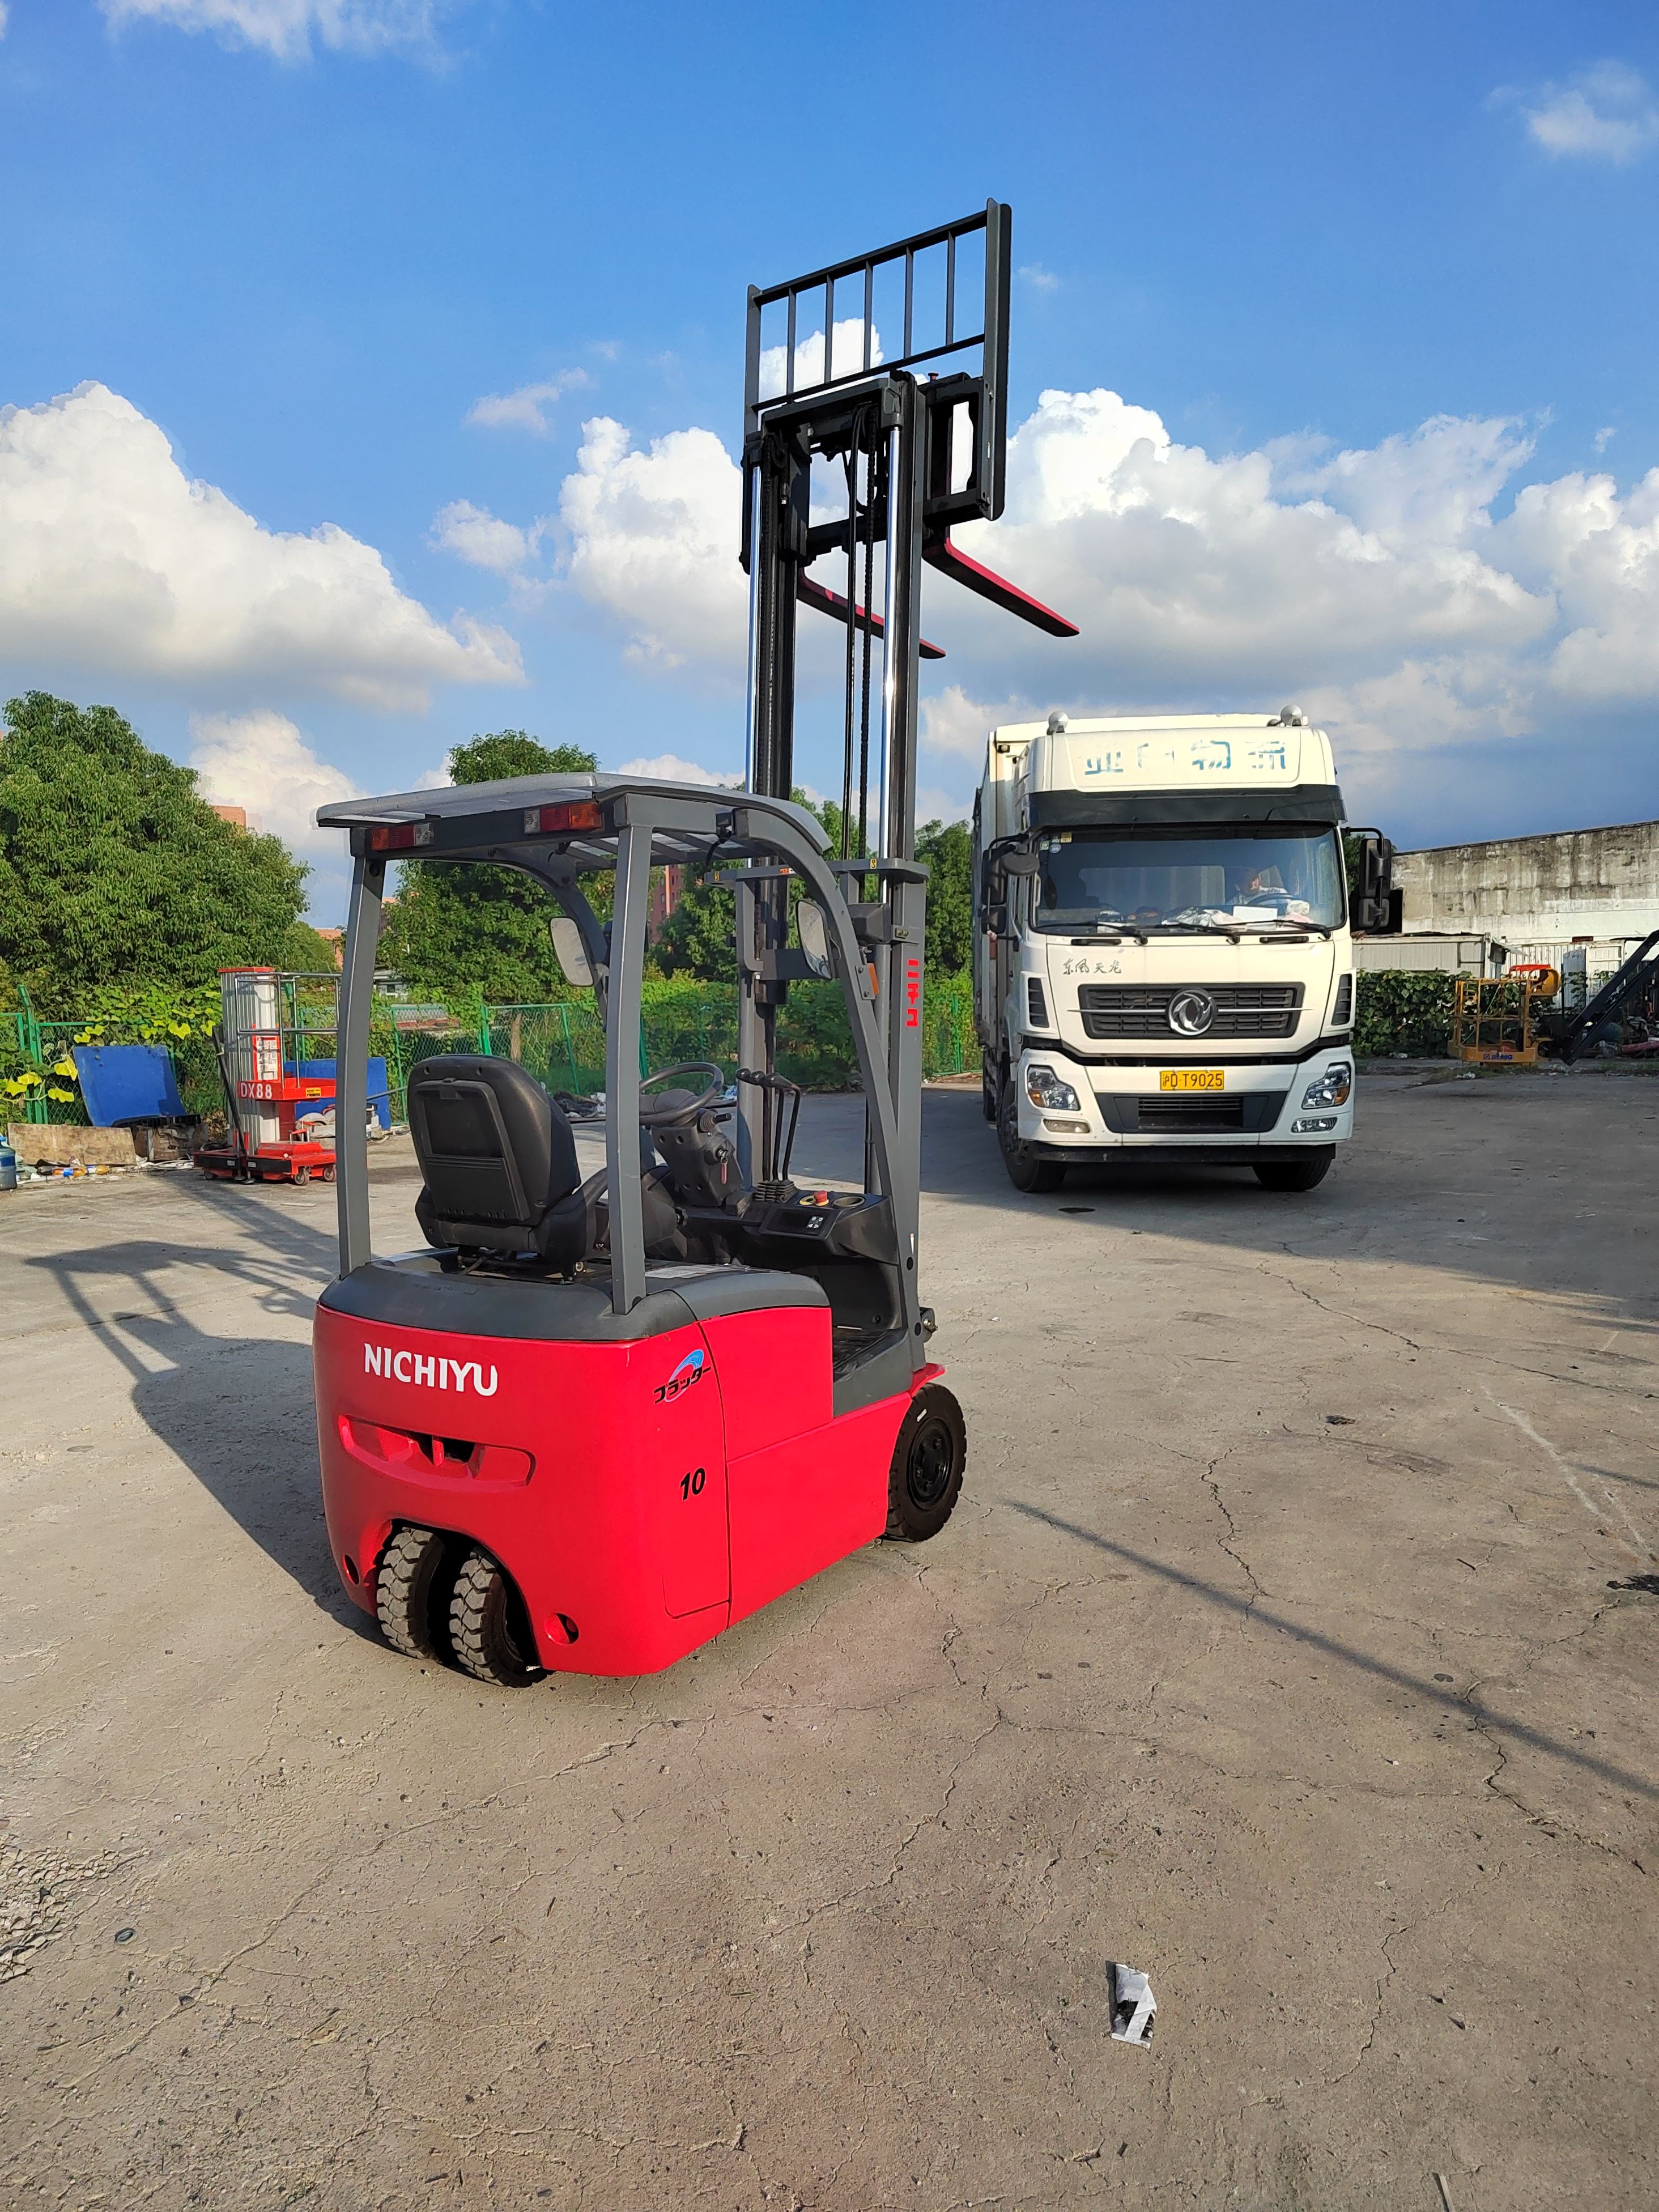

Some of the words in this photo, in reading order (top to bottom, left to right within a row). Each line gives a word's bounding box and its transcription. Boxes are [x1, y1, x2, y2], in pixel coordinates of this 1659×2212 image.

[241, 1082, 272, 1099] DX88
[364, 1343, 497, 1396] NICHIYU
[680, 1467, 705, 1501] 10
